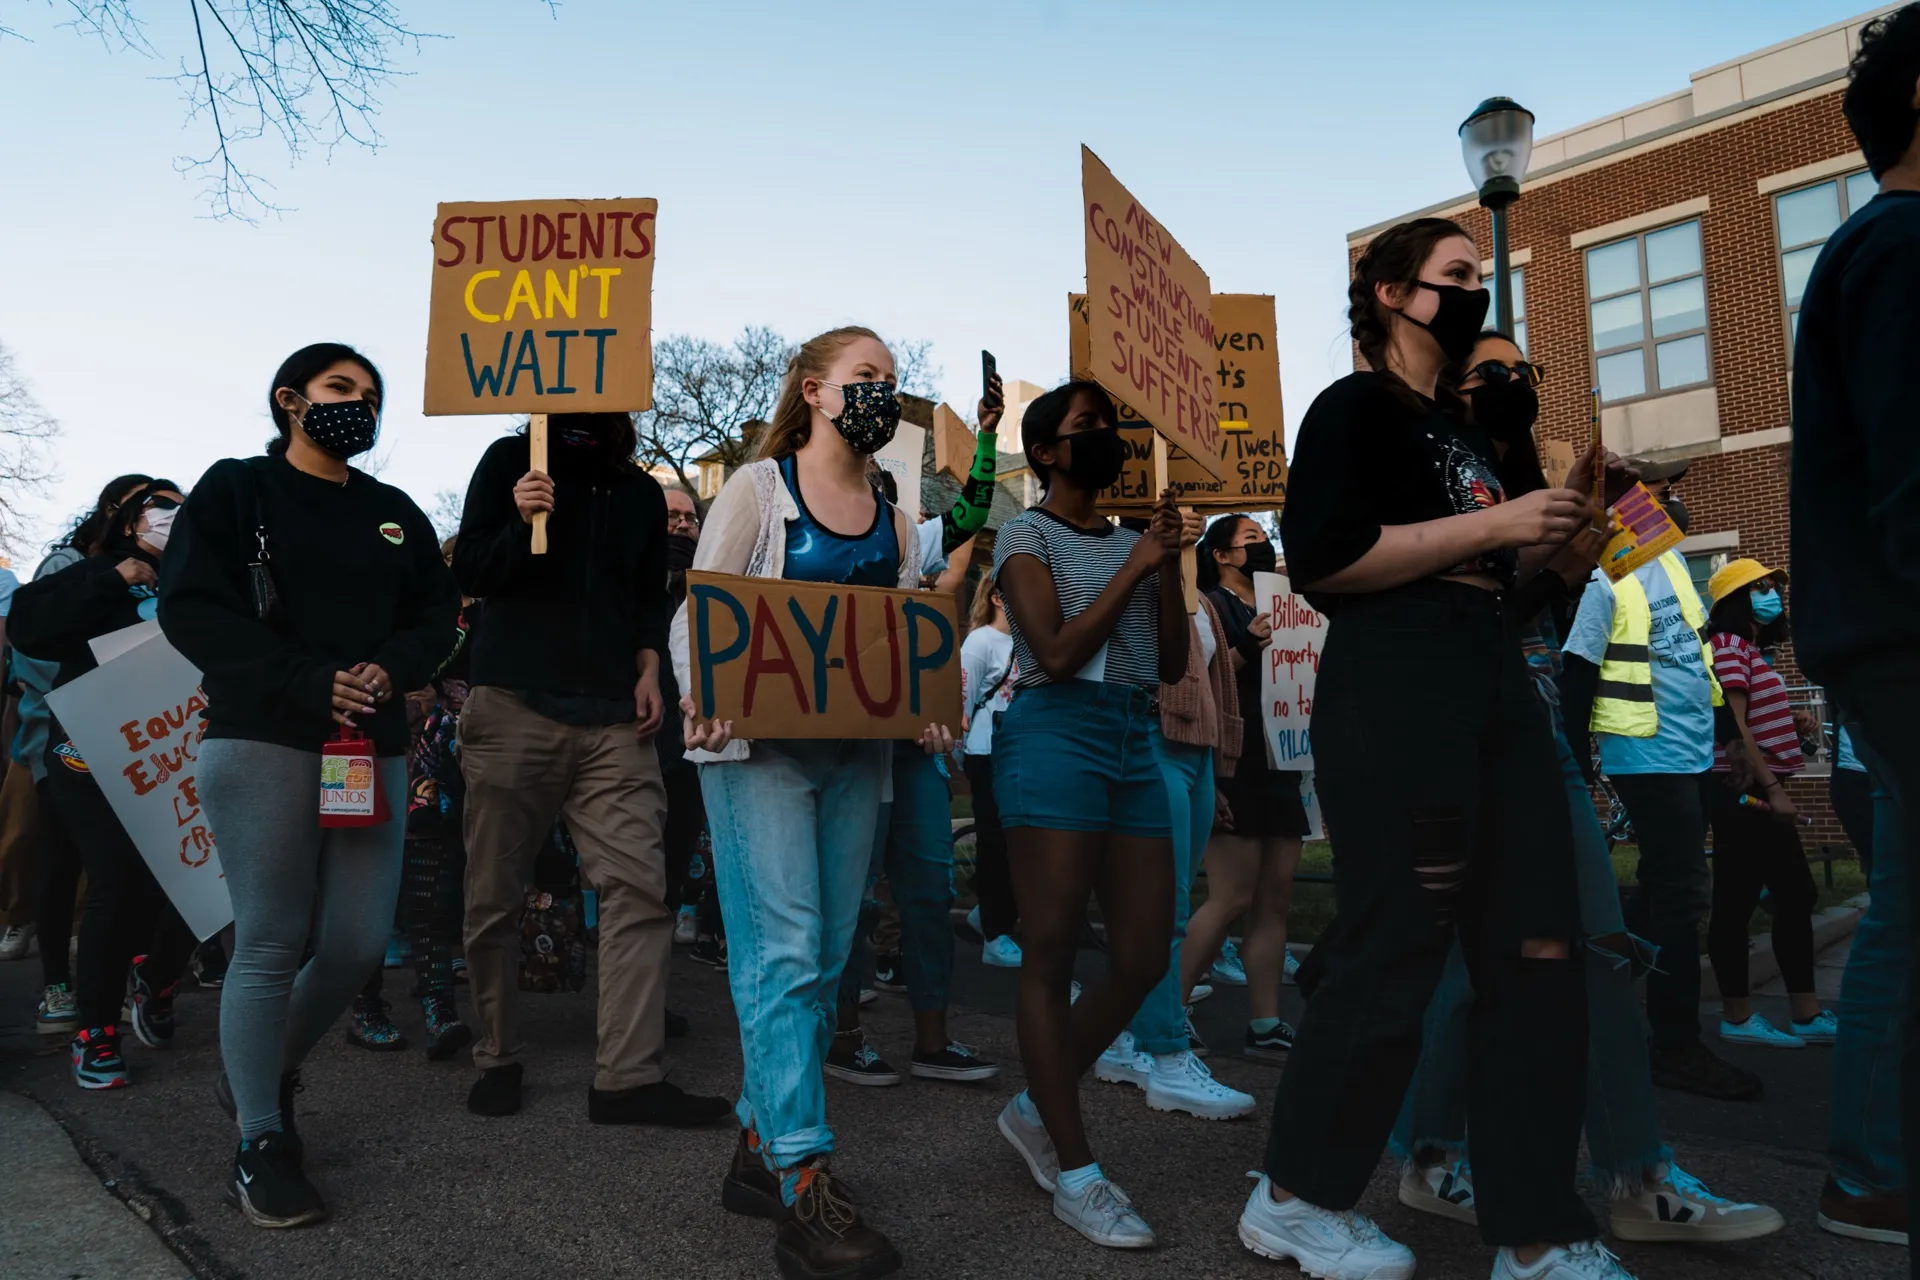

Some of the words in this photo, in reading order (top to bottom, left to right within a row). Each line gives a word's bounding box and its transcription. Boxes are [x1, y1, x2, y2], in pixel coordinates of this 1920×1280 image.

[437, 211, 655, 267] STUDENTS
[1125, 202, 1171, 265] NEW
[464, 264, 622, 323] CAN'T
[1089, 202, 1216, 348] CONSTRUCTION
[1131, 273, 1184, 345] WHILE
[460, 329, 617, 398] WAIT
[1107, 285, 1213, 407] STUDENTS
[1168, 478, 1228, 497] rganizer
[1237, 460, 1282, 480] SPD
[1272, 594, 1322, 631] Billions
[690, 583, 955, 720] PAY-UP
[1271, 641, 1319, 684] property
[1273, 700, 1289, 718] no
[1297, 684, 1312, 716] ta
[1278, 728, 1312, 762] PILO
[320, 789, 367, 806] JUNTOS
